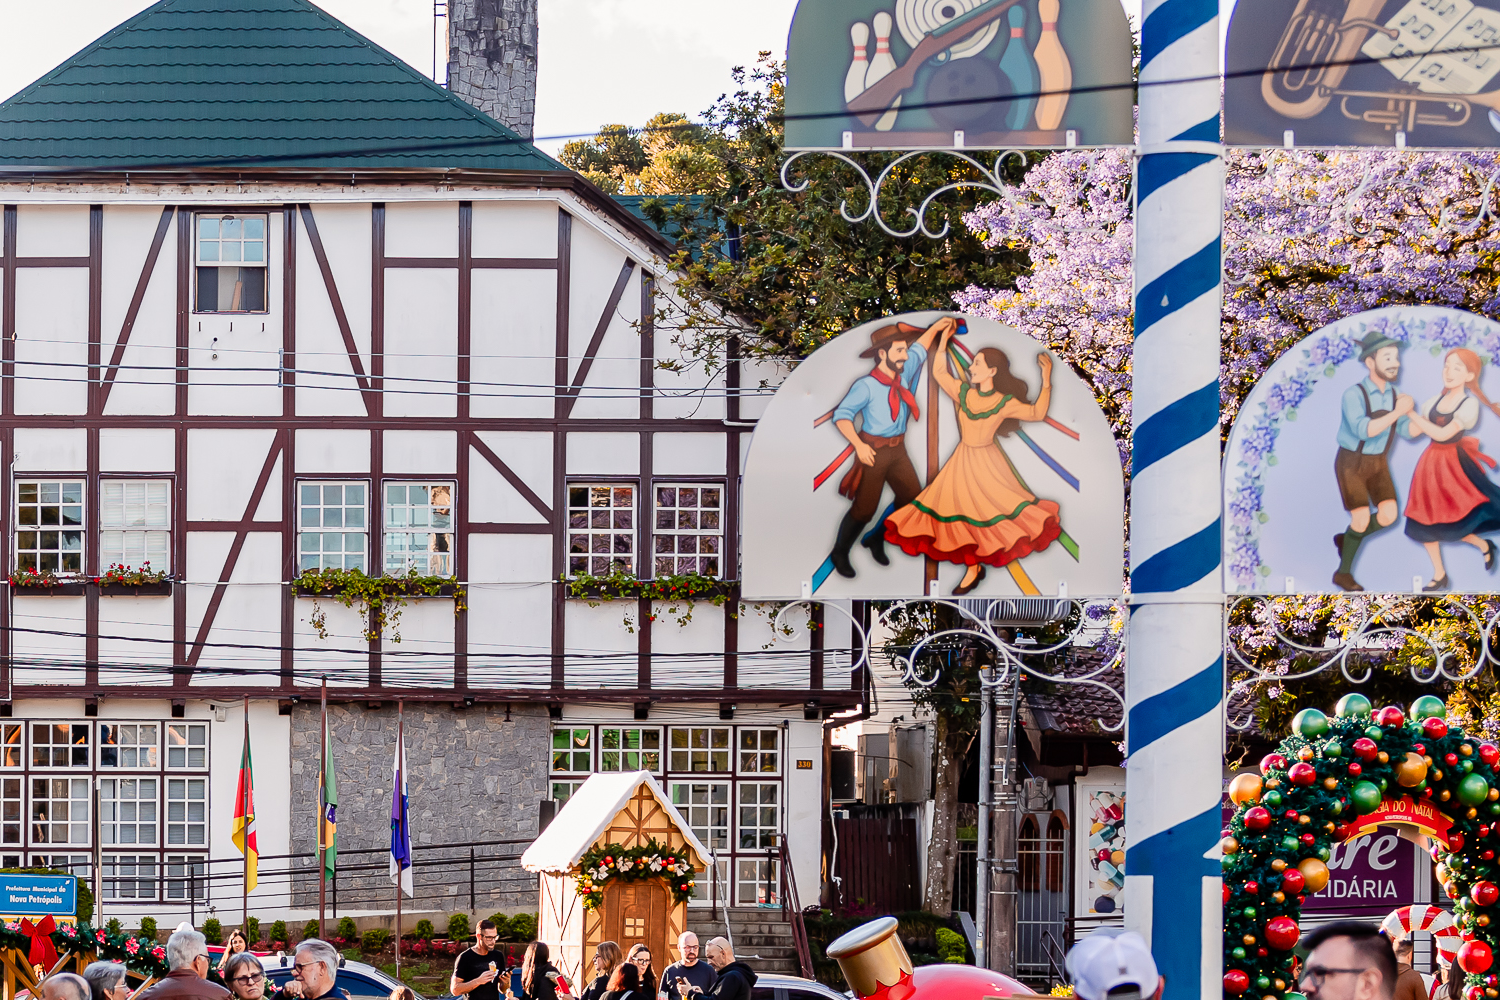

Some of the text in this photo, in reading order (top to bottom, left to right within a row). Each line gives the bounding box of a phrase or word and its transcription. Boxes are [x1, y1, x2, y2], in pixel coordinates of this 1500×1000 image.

[1393, 800, 1406, 812] DO
[1411, 803, 1434, 820] NATAL
[10, 894, 62, 905] Nova Petrópolis
